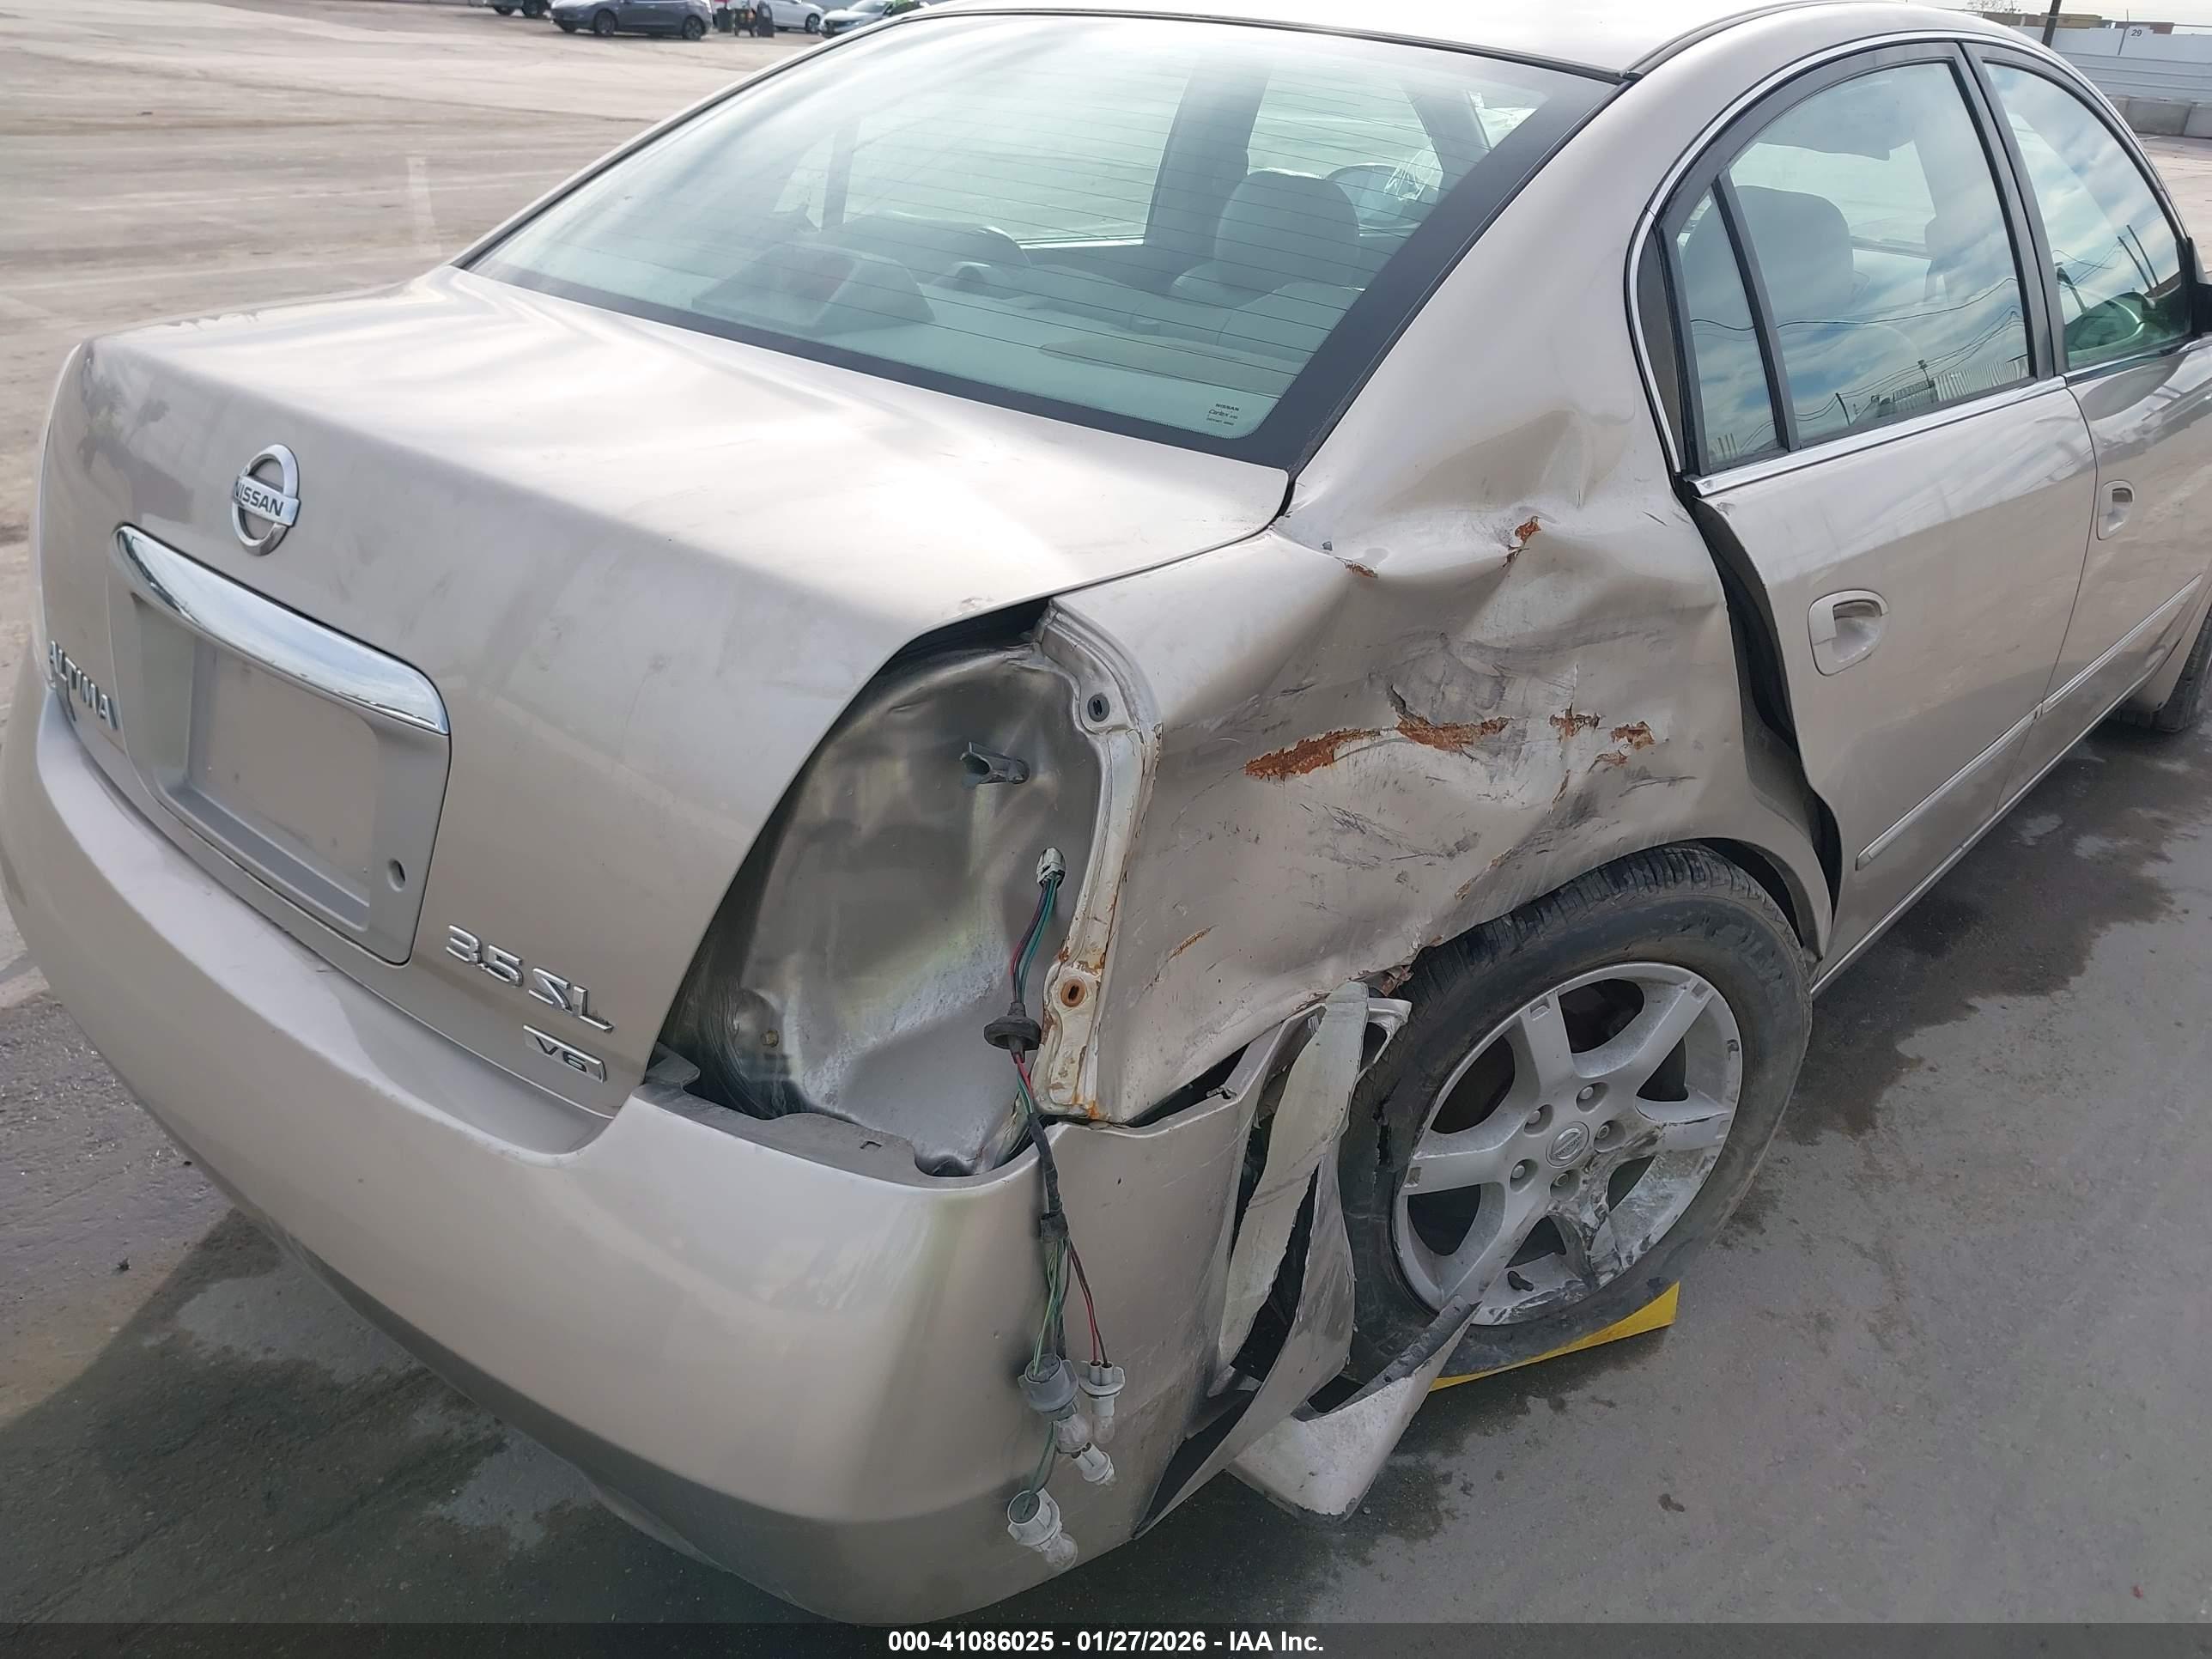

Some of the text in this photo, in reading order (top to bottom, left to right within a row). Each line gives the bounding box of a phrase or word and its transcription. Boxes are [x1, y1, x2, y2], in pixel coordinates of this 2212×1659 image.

[234, 478, 284, 517] NISSAN
[50, 640, 118, 731] ALTIMA
[528, 967, 614, 1033] SL
[535, 1034, 587, 1073] V6
